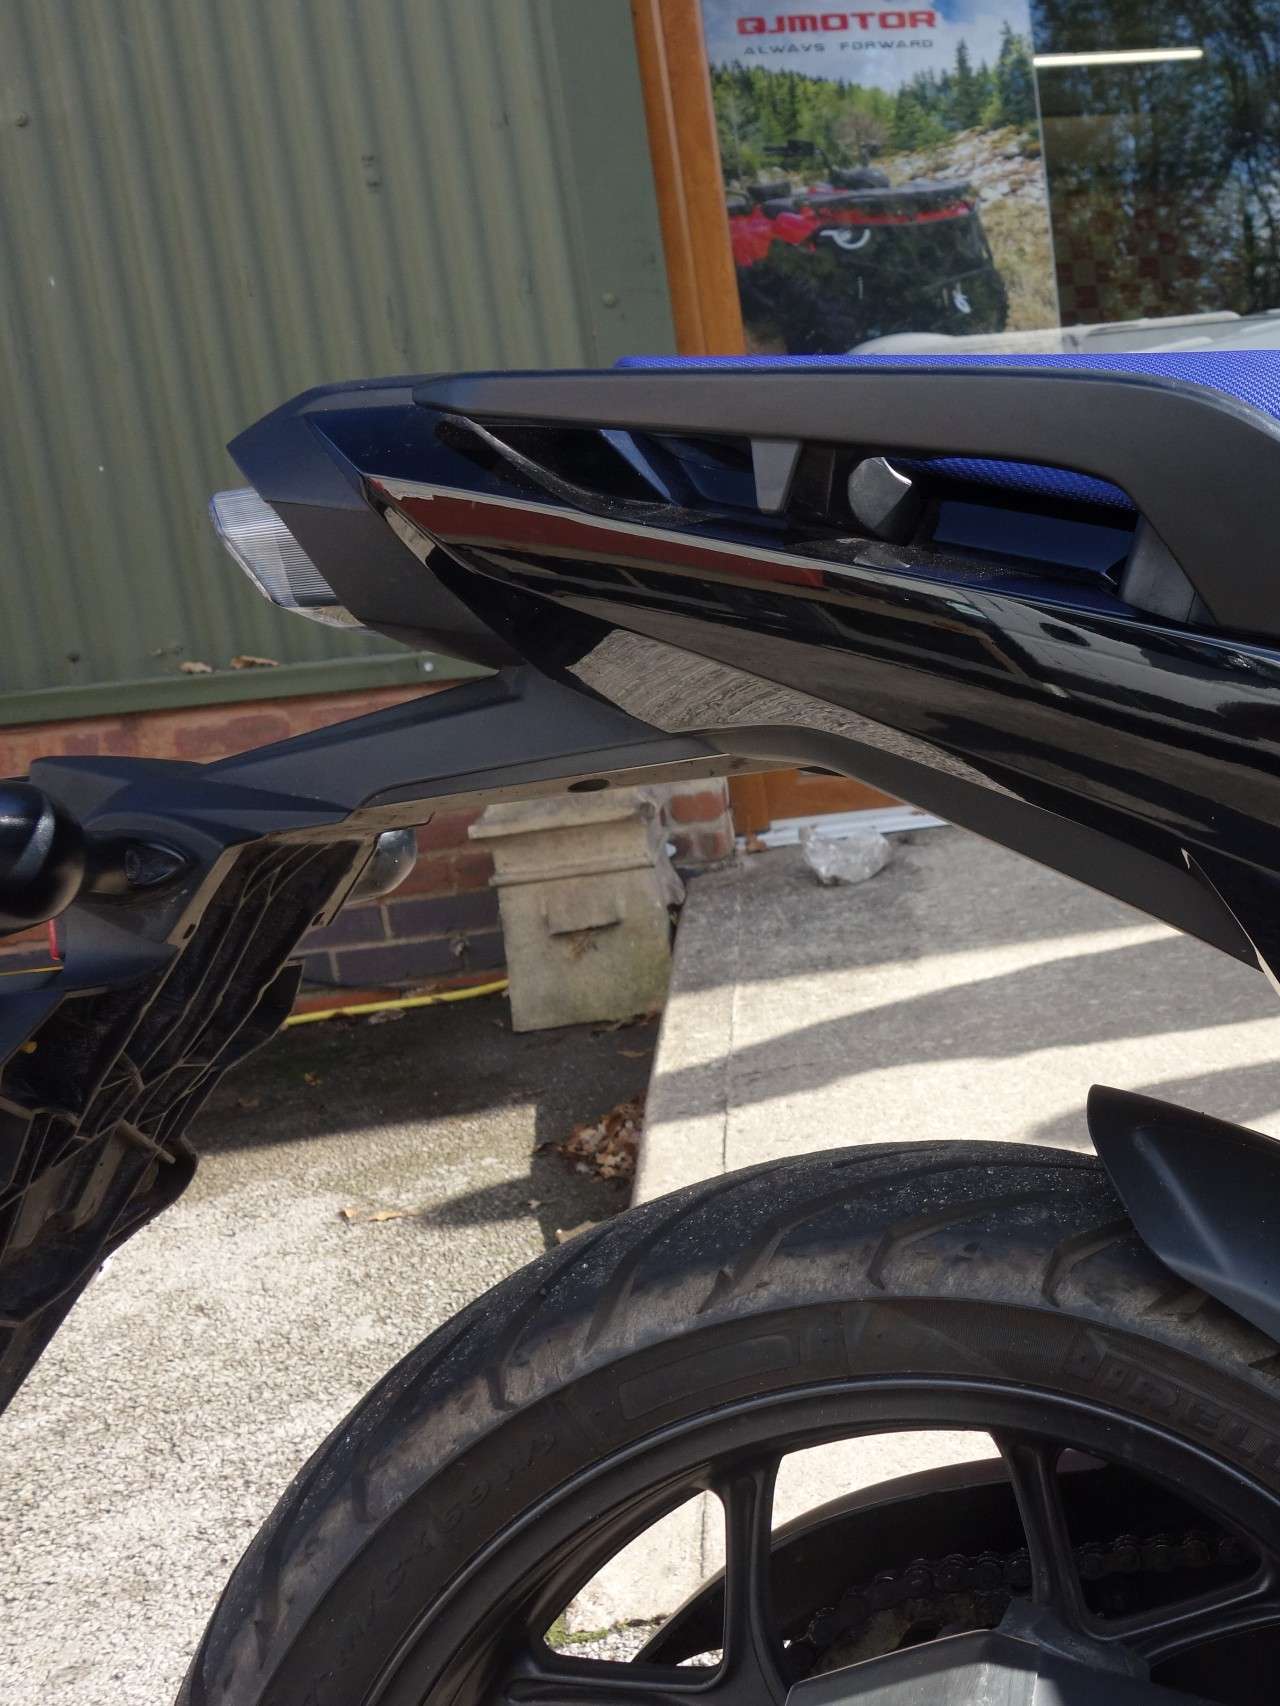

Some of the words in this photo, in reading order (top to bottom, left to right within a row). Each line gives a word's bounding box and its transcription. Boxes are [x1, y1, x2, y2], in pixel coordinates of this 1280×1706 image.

[737, 11, 936, 34] QJMOTOR
[744, 43, 825, 55] ALWAYS
[839, 39, 933, 50] FORWARD
